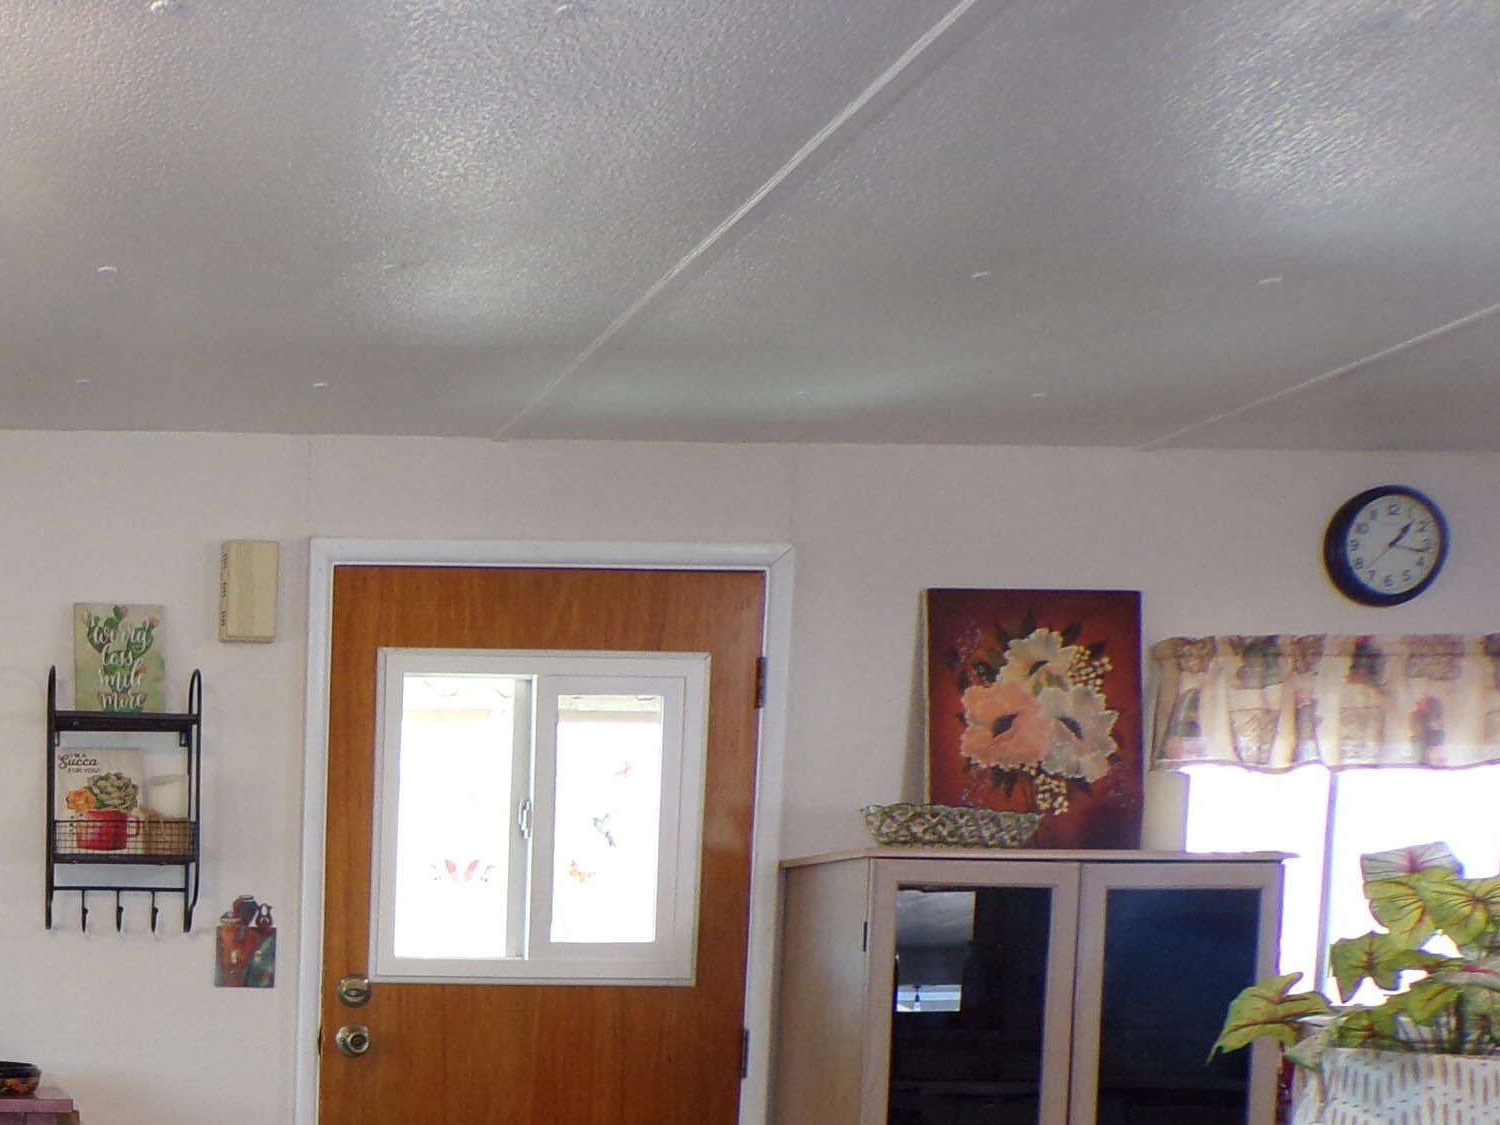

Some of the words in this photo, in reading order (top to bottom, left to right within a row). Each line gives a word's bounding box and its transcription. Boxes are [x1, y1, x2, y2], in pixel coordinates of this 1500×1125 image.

[1388, 504, 1400, 516] 12
[1416, 556, 1425, 567] 4
[93, 624, 149, 654] worry
[102, 643, 133, 665] less
[98, 658, 144, 691] smile
[101, 692, 145, 710] more
[59, 754, 99, 769] Succa
